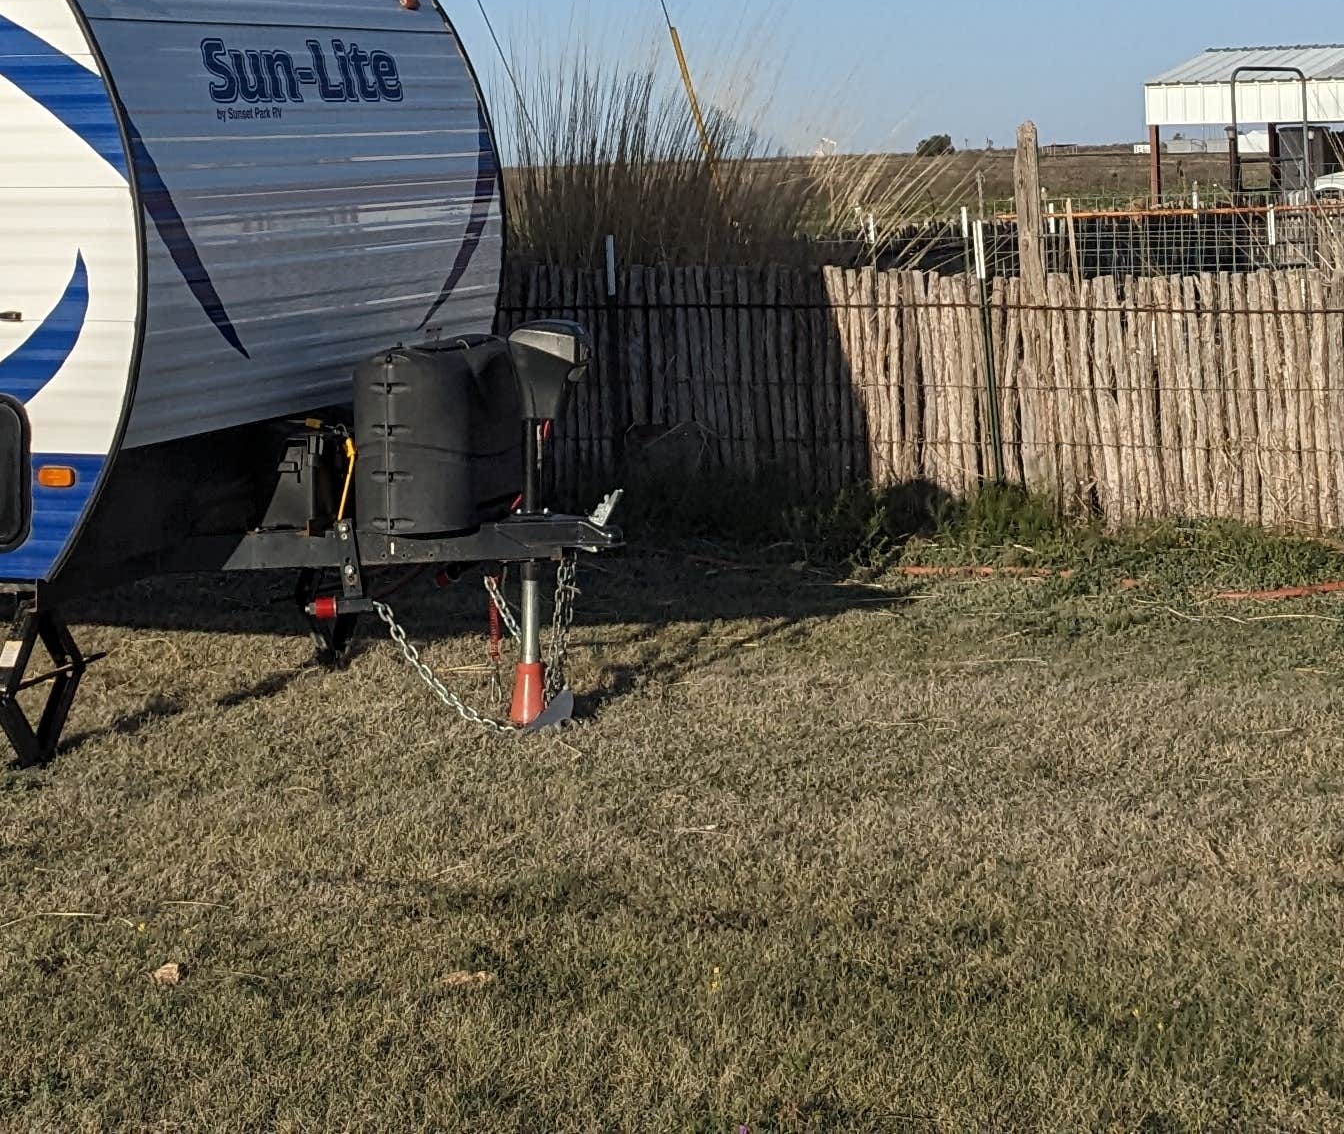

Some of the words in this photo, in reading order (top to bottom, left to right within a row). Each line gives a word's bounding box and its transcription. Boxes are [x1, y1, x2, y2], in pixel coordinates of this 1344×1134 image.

[200, 37, 404, 103] Sun-Lite
[216, 108, 226, 122] by
[227, 107, 253, 119] Sunset
[254, 107, 271, 119] Park
[272, 107, 282, 119] RV
